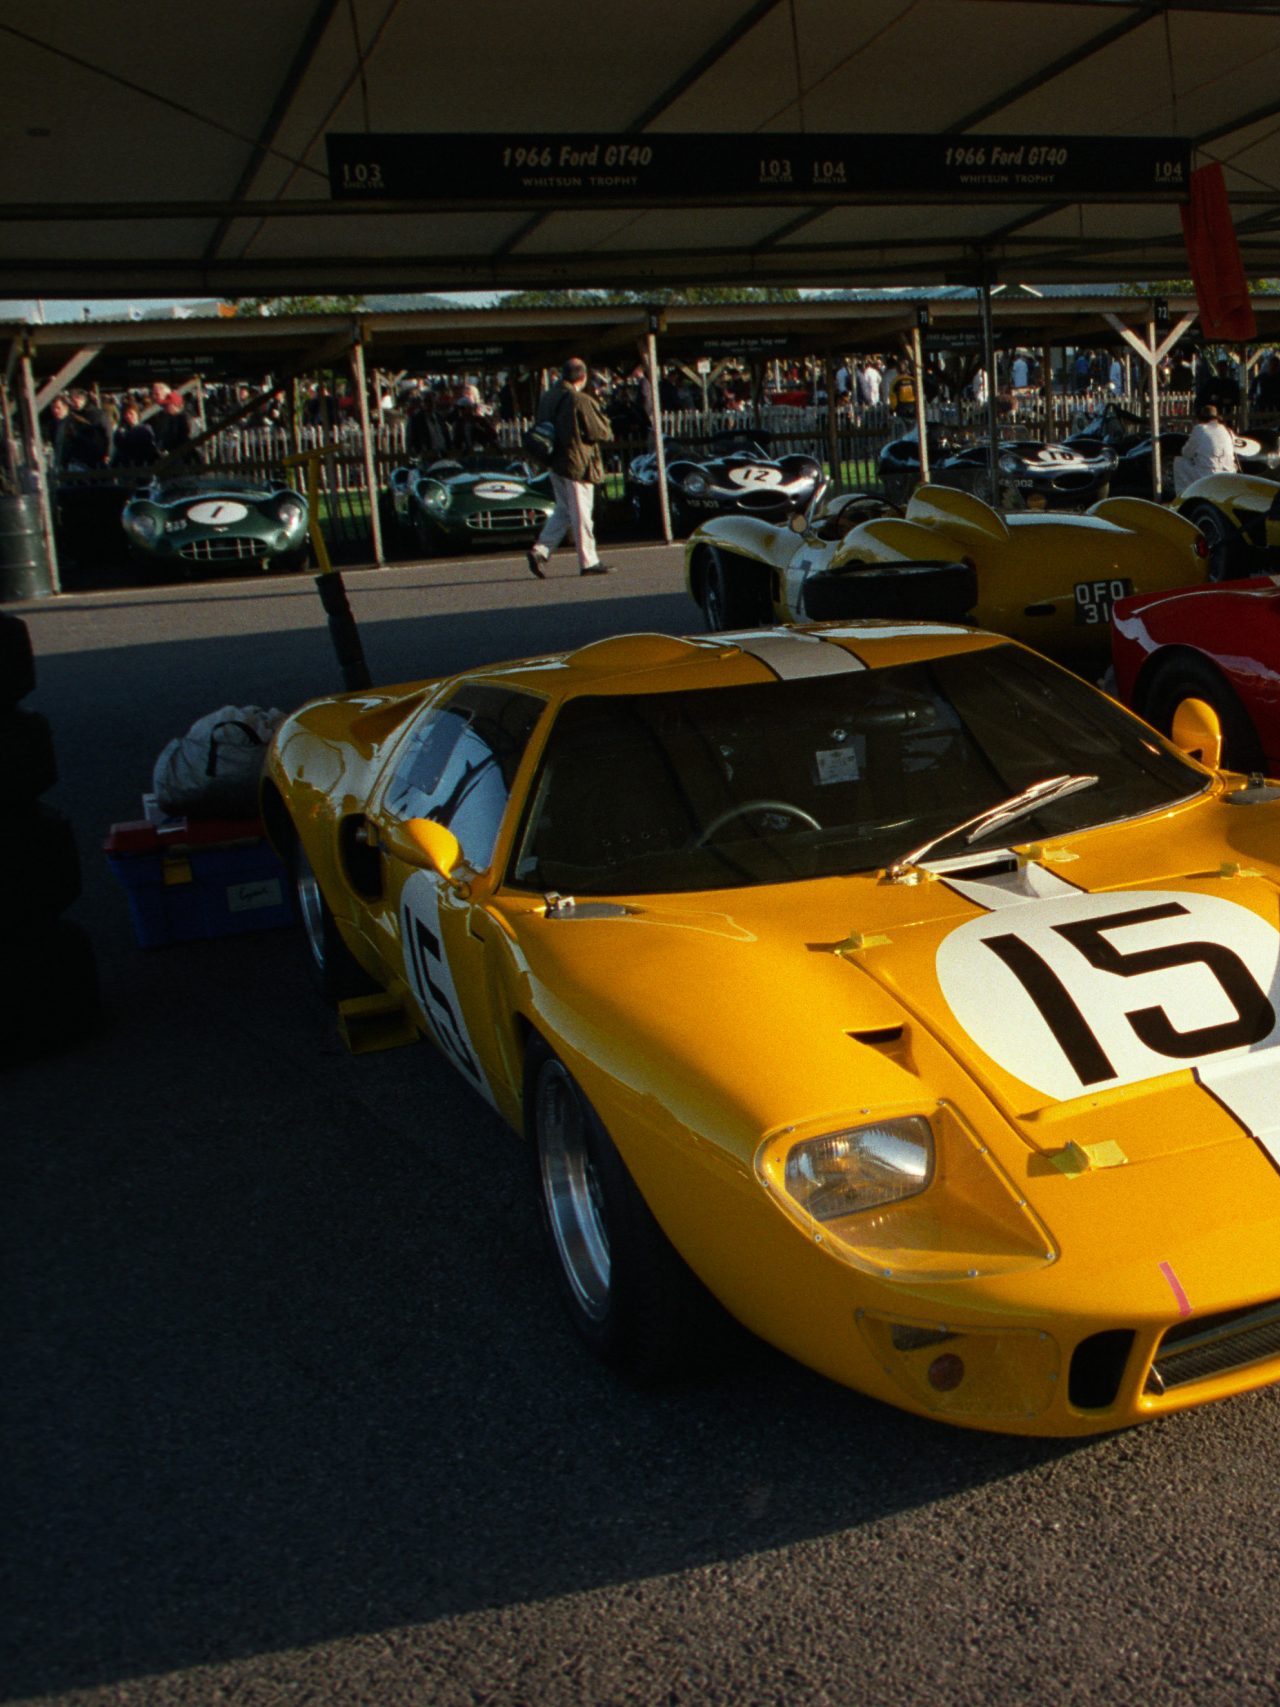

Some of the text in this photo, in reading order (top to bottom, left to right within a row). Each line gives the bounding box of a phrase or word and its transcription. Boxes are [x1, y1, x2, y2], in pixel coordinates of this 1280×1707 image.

[502, 144, 652, 168] 1966 Ford GT40
[945, 145, 1068, 166] 1966 Ford GT40
[342, 163, 382, 182] 103
[759, 160, 792, 177] 103
[813, 161, 846, 177] 104
[1154, 162, 1182, 176] 104
[522, 176, 638, 187] WHITSUN TROPHY
[960, 174, 1055, 183] WHITSUN TROPHY
[742, 469, 770, 482] 12
[211, 506, 224, 518] 1
[1084, 602, 1110, 624] 31
[404, 904, 482, 1083] 15
[979, 902, 1276, 1087] 15
